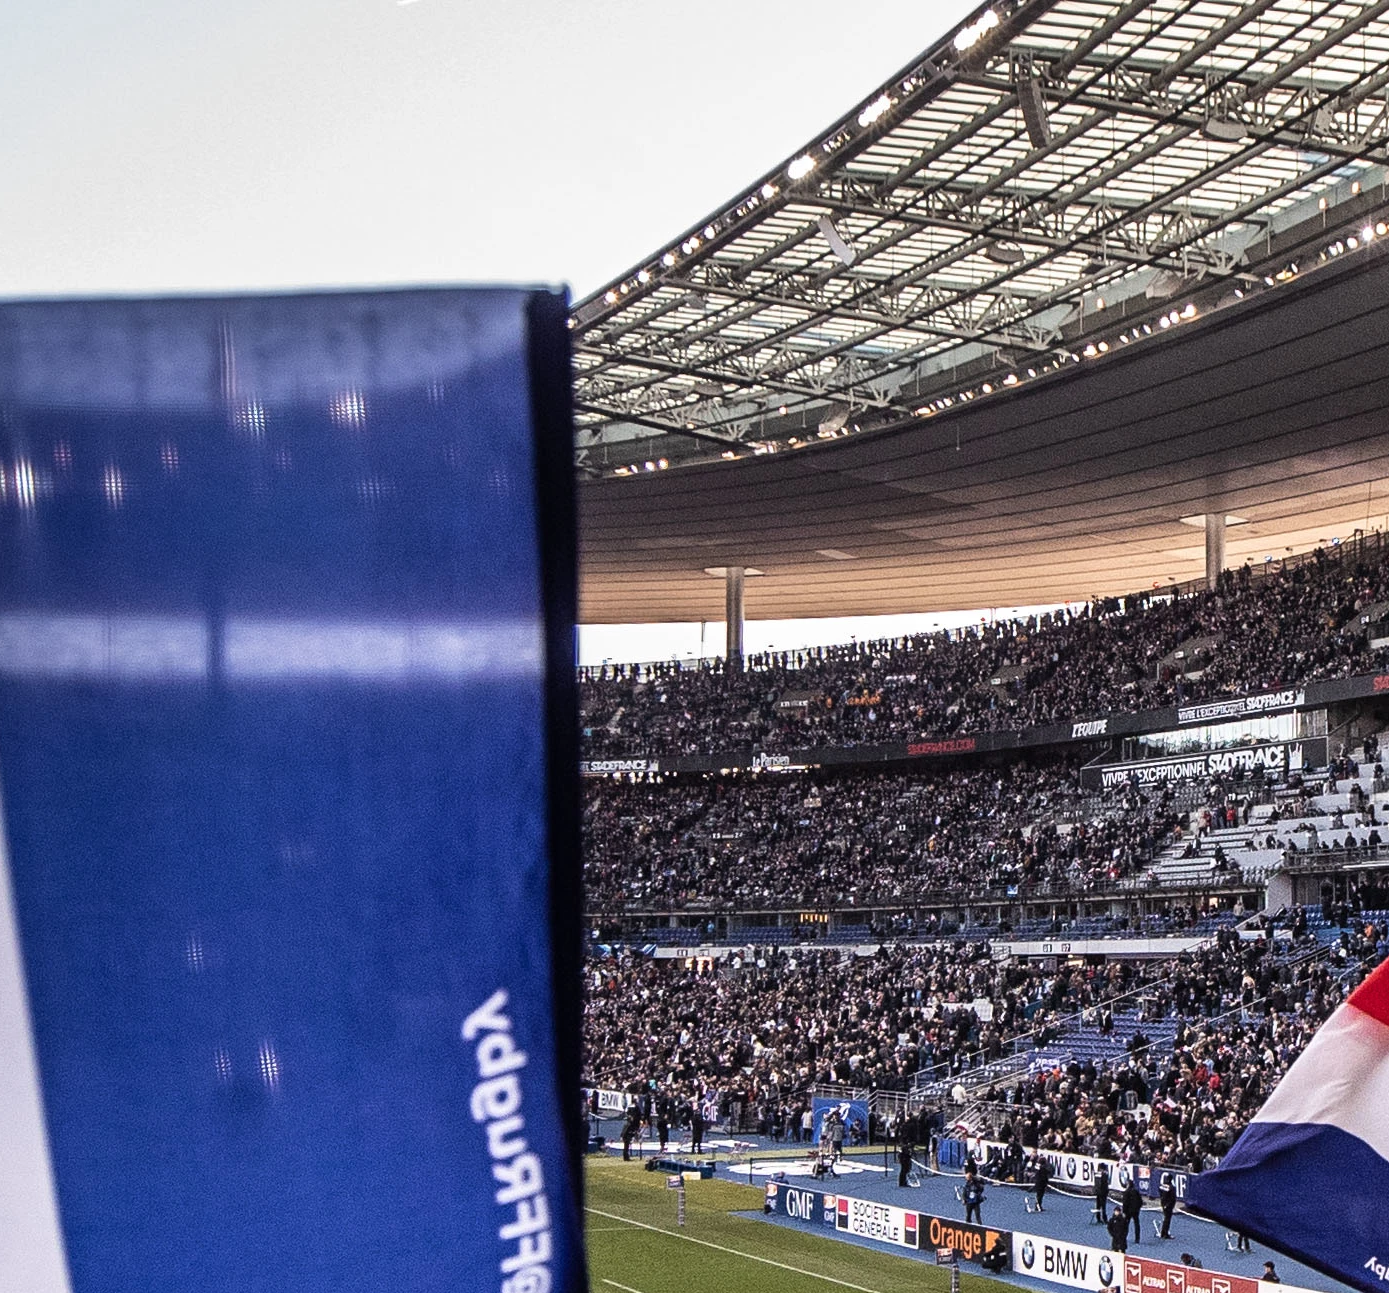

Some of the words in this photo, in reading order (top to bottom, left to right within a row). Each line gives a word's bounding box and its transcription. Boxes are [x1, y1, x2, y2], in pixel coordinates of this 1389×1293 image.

[1178, 709, 1195, 721] VIVRE
[786, 1188, 814, 1220] GMF
[853, 1201, 890, 1223] SOCIETE
[853, 1218, 899, 1241] GENERALE
[929, 1218, 981, 1259] Orange
[1044, 1245, 1088, 1281] BMW
[1142, 1275, 1166, 1289] ALTRAD
